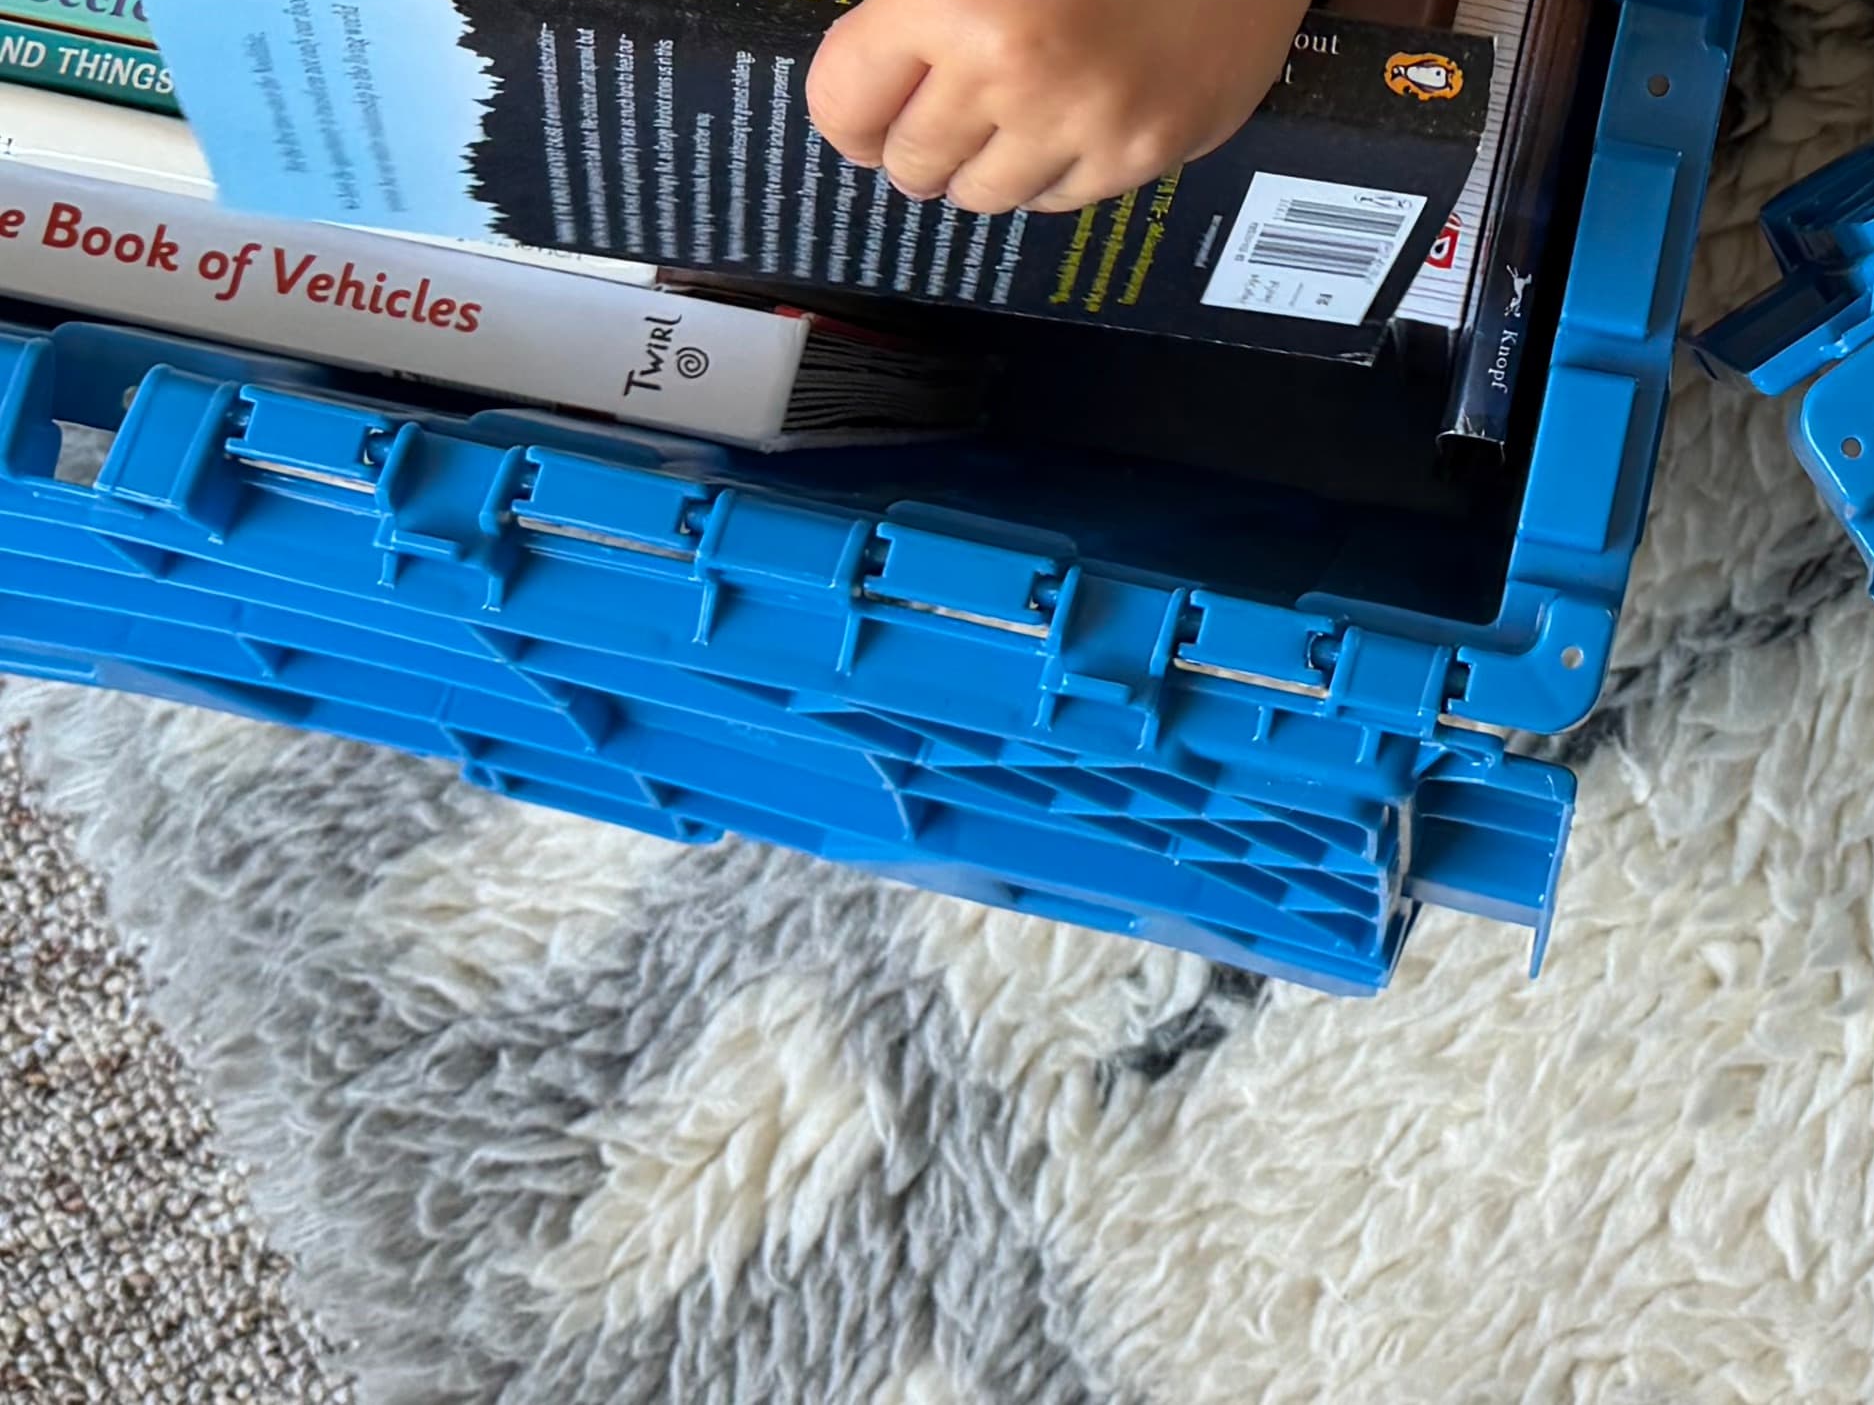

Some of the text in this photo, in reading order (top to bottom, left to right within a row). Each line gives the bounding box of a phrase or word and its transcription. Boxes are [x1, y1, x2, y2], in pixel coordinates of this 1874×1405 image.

[42, 202, 178, 272] Book
[198, 243, 262, 301] of
[274, 248, 481, 333] Vehicles
